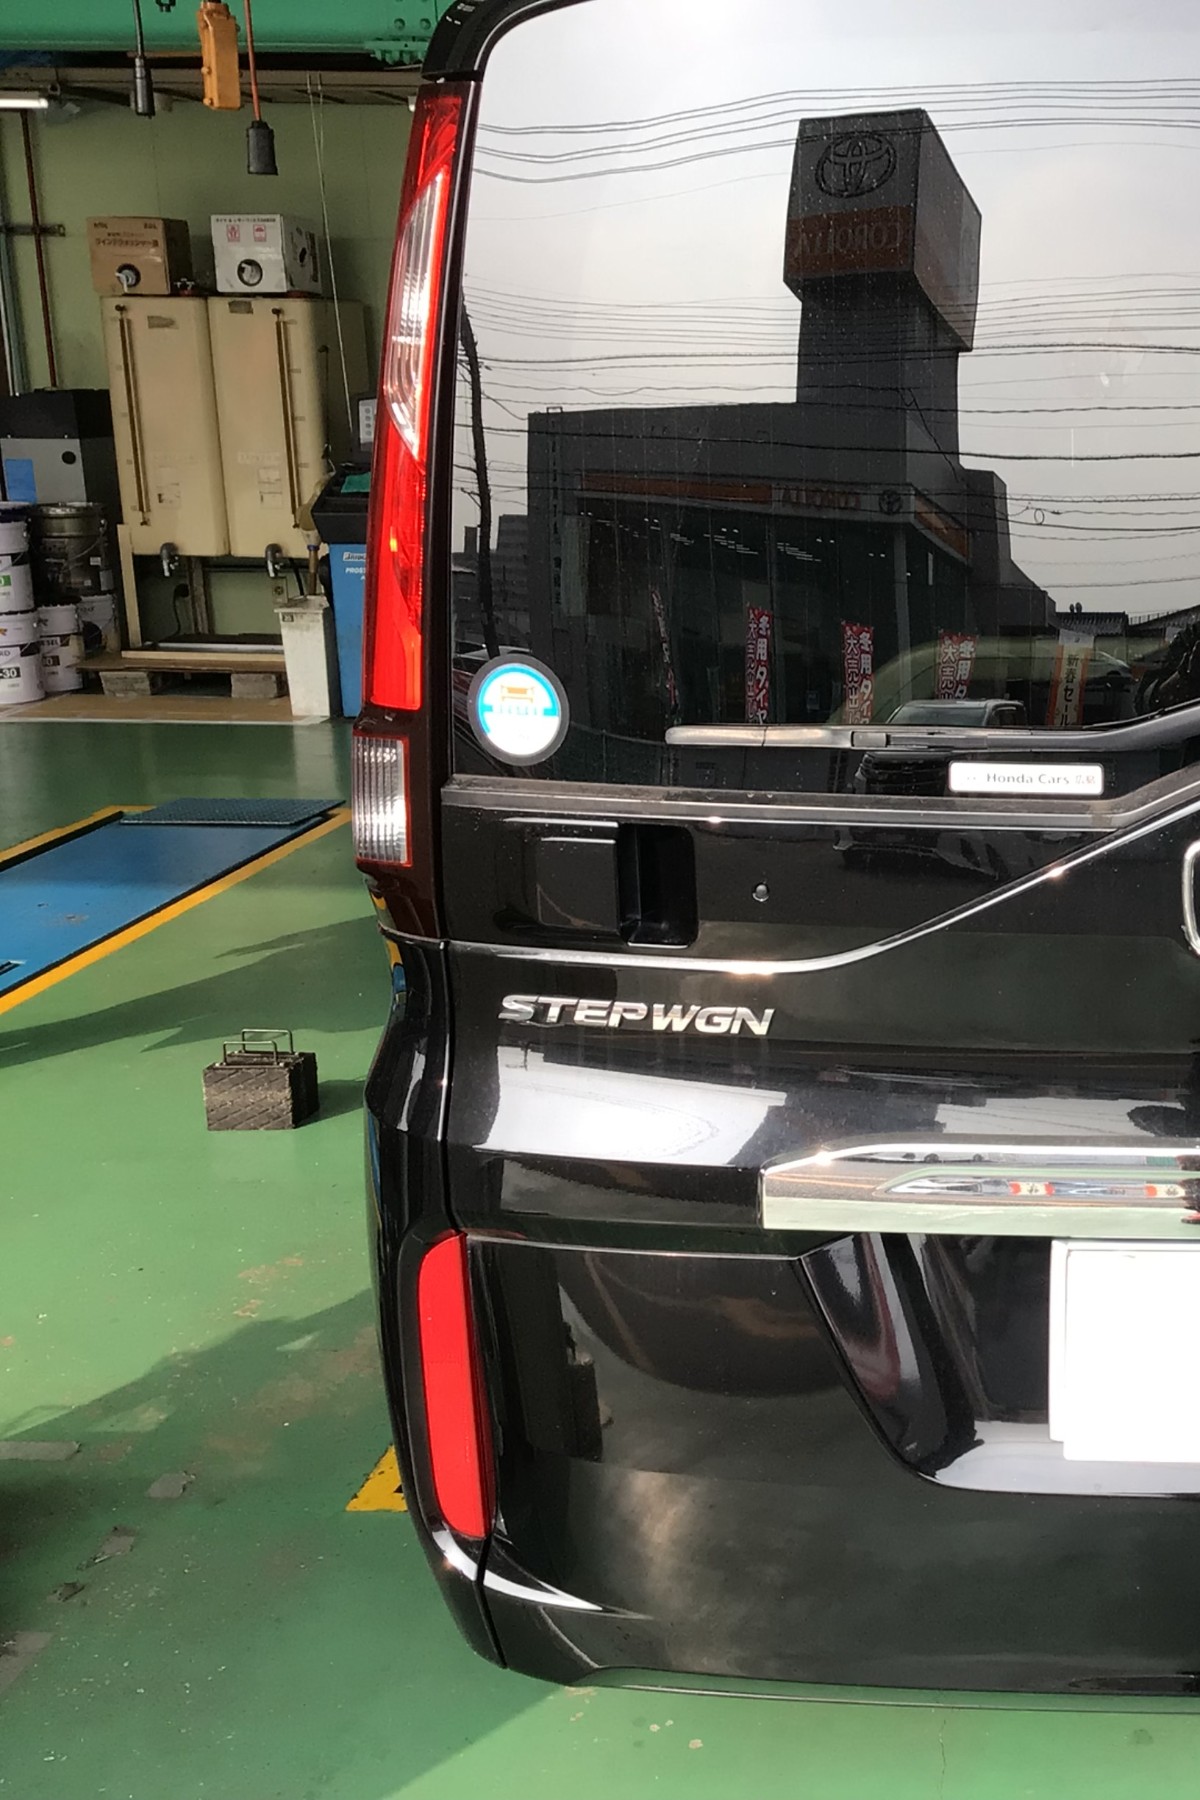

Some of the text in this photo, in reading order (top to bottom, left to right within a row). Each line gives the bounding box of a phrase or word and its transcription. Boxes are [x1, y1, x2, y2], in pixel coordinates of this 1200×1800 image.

[986, 772, 1034, 784] Honda
[1038, 773, 1070, 785] Cars
[497, 993, 776, 1036] STEPWGN
